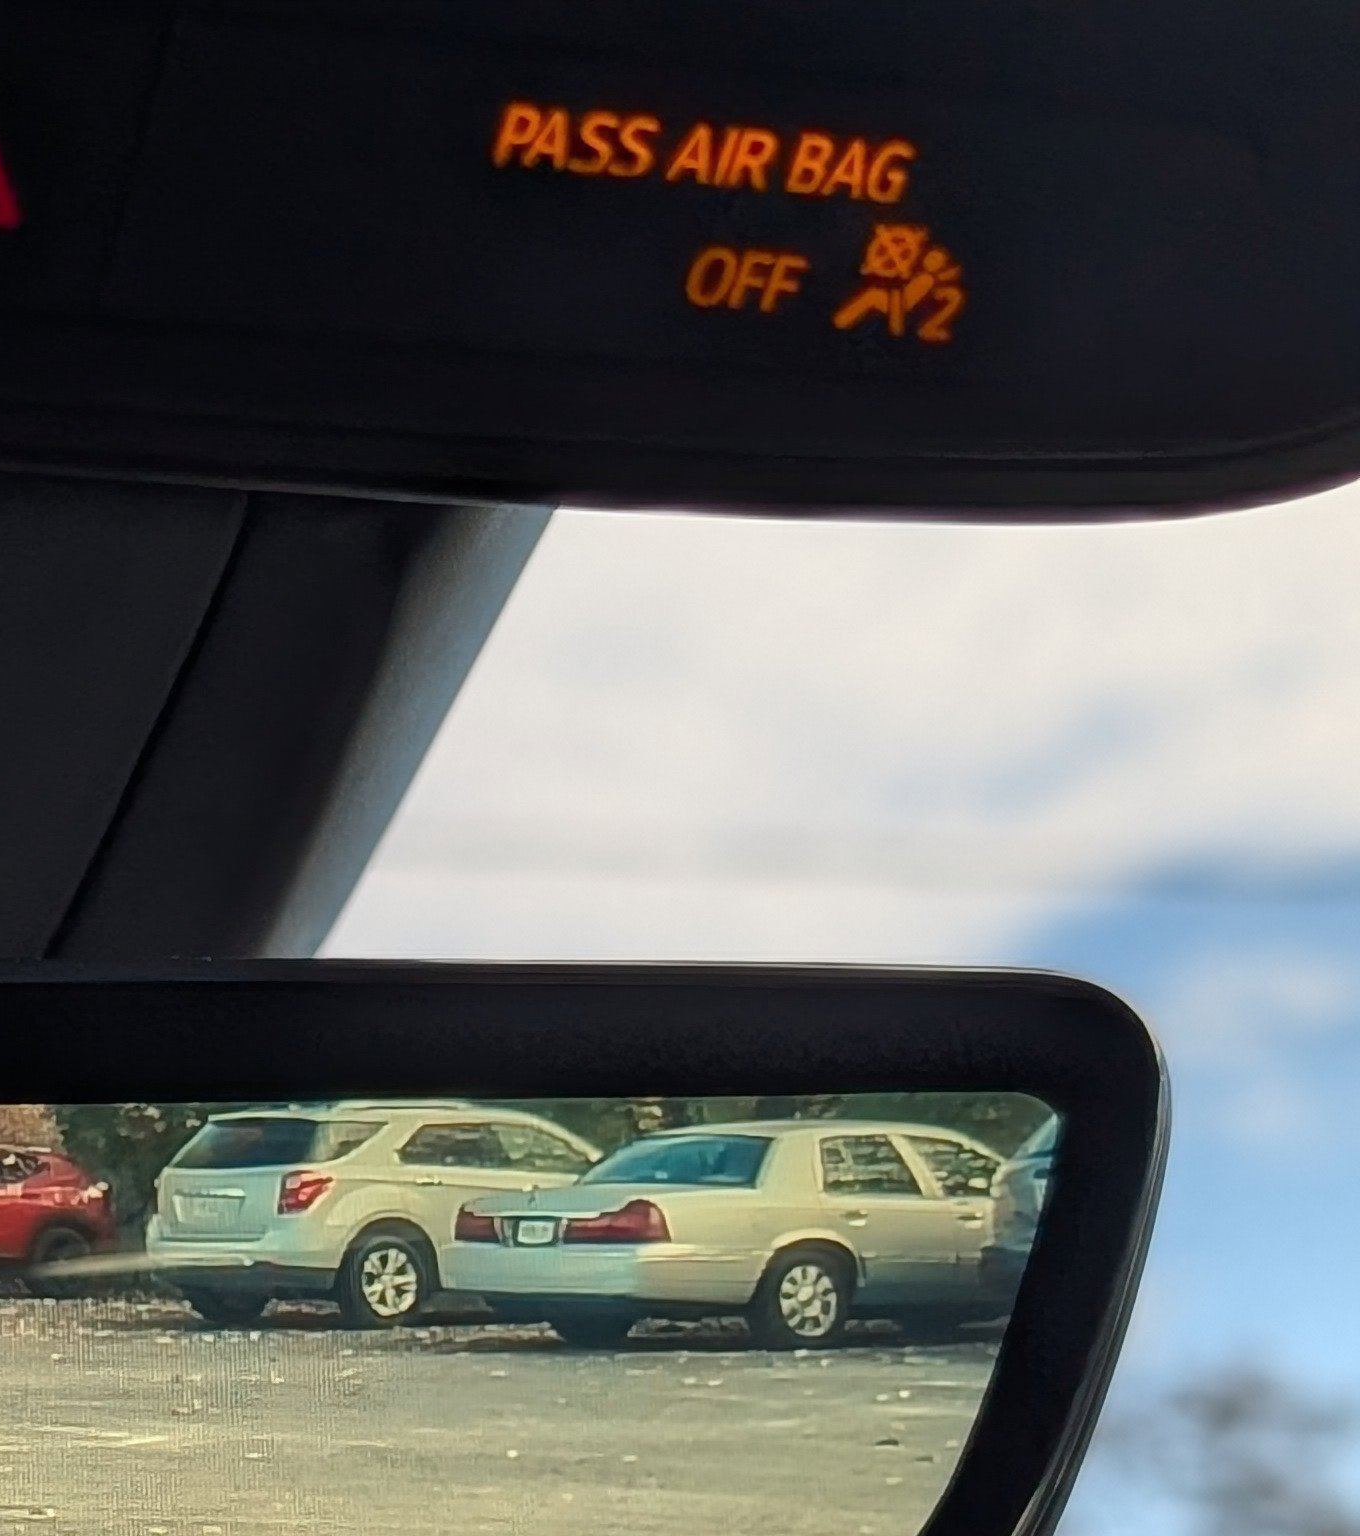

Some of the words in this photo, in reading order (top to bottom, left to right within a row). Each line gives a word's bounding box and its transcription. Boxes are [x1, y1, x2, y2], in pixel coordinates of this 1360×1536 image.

[492, 102, 661, 178] PASS
[664, 122, 778, 192] AIR
[785, 131, 918, 203] BAG
[685, 246, 809, 313] OFF
